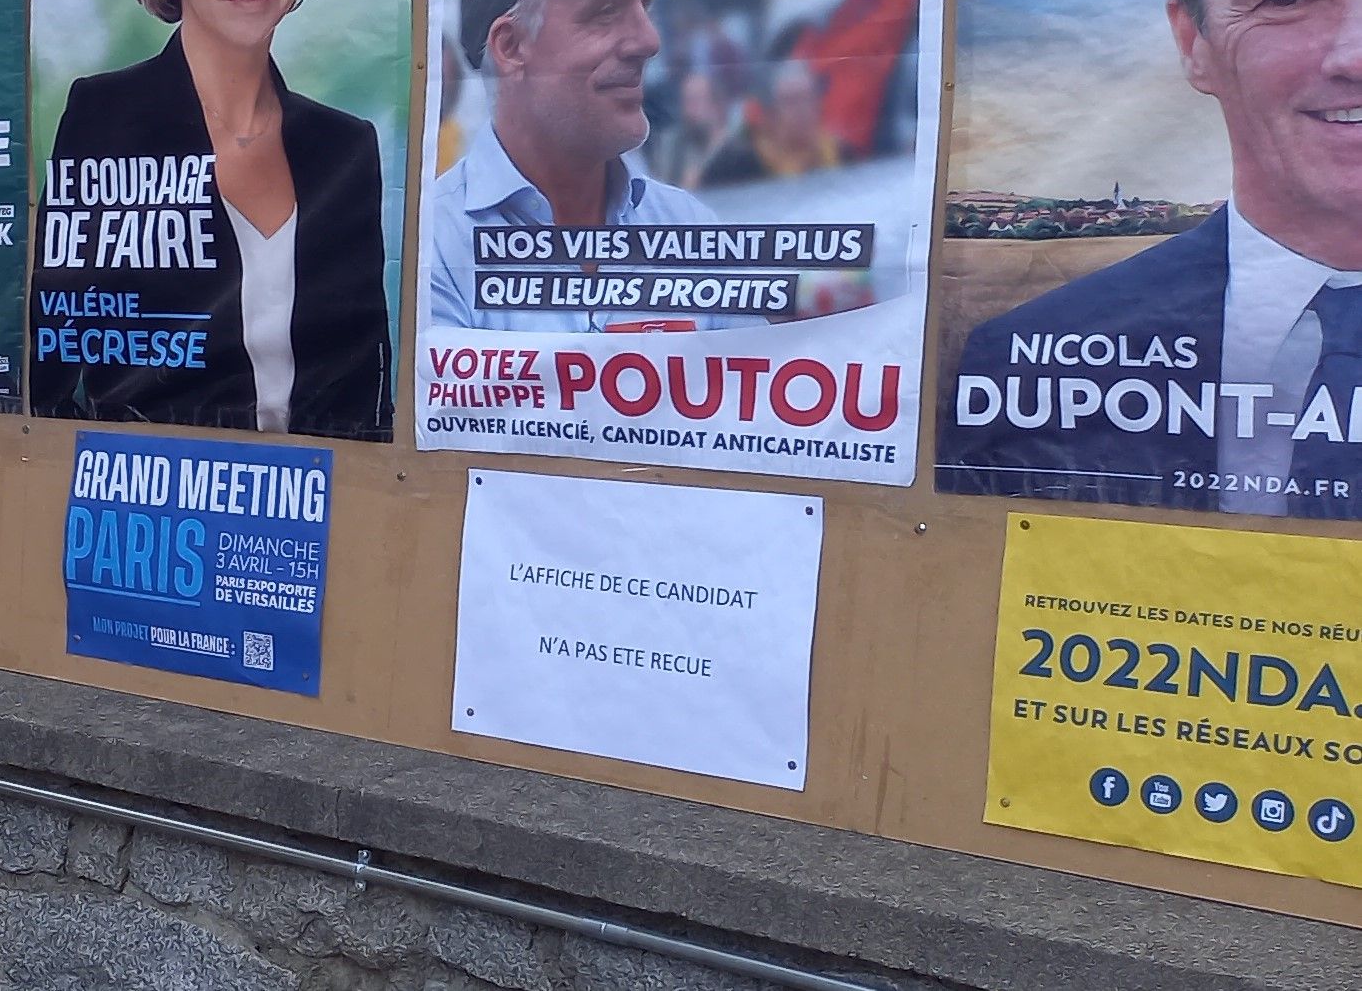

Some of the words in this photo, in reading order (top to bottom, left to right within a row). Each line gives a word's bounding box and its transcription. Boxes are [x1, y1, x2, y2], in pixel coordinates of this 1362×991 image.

[45, 159, 75, 207] LE
[80, 153, 217, 207] COURAGE
[43, 211, 90, 268] DE
[95, 209, 217, 269] FAIRE
[479, 229, 553, 259] NOS
[564, 230, 628, 260] VIES
[639, 230, 765, 261] VALENT
[774, 230, 862, 262] PLUS
[40, 286, 139, 319] VALÉRIE
[480, 277, 543, 307] QUE
[550, 278, 643, 308] LEURS
[649, 278, 789, 310] PROFITS
[38, 319, 207, 369] PÉCRESSE
[1010, 333, 1198, 369] NICOLAS
[428, 347, 541, 381] VOTEZ
[428, 382, 545, 409] PHILIPPE
[553, 351, 902, 432] POUTOU
[426, 417, 506, 436] OUVRIER
[511, 419, 595, 442] LICENCIÉ,
[602, 426, 707, 450] CANDIDAT
[712, 432, 896, 464] ANTICAPITALISTE
[74, 450, 171, 506] GRAND
[178, 458, 326, 523] MEETING
[1173, 470, 1349, 498] 2022NDA.FR
[66, 505, 205, 598] PARIS
[218, 532, 320, 561] DIMANCHE
[216, 553, 225, 570] 3
[229, 554, 272, 575] AVRIL
[289, 561, 319, 580] 15H
[215, 589, 232, 603] DE
[235, 591, 315, 614] VERSAILLES
[216, 575, 245, 589] PARIS
[247, 579, 276, 593] EXPO
[278, 582, 316, 598] PORTE
[510, 563, 595, 590] L'AFFICHE
[600, 575, 623, 594] DE
[627, 578, 650, 597] CE
[655, 581, 759, 610] CANDIDAT
[93, 616, 114, 633] MON
[115, 621, 149, 640] PROJET
[151, 626, 177, 647] POUR
[178, 631, 190, 647] LA
[191, 633, 230, 653] FRANCE
[1025, 594, 1132, 618] RETROUVEZ
[1138, 606, 1169, 622] LES
[1175, 610, 1234, 629] DATES
[1240, 616, 1267, 632] DE
[1271, 620, 1313, 637] NOS
[1320, 623, 1362, 642] RÉU
[539, 636, 570, 657] N'A
[575, 641, 608, 661] PAS
[613, 647, 645, 667] ETE
[651, 652, 712, 677] RECUE
[1013, 698, 1047, 720] ET
[1052, 704, 1108, 731] SUR
[1117, 712, 1166, 738] LES
[1176, 718, 1315, 759] RÉSEAUX
